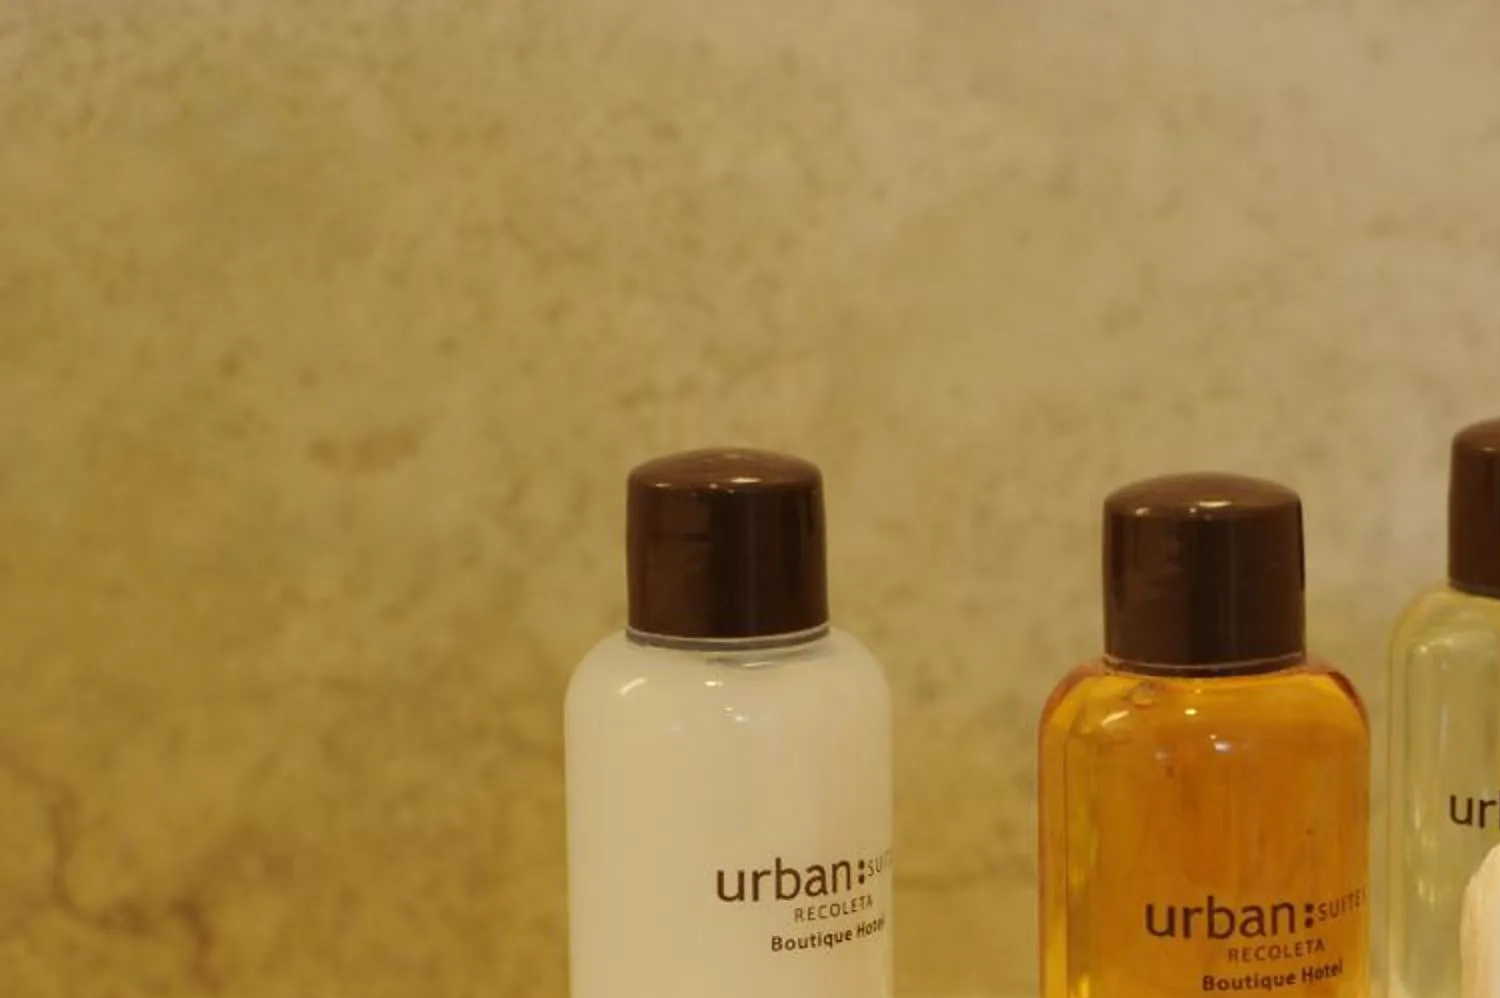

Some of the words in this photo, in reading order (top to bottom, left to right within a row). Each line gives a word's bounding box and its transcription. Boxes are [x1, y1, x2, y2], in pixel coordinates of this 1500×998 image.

[793, 894, 874, 923] RECOLETA
[771, 928, 853, 952] Boutique
[1227, 938, 1326, 963] RECOLETA
[1202, 972, 1297, 992] Boutique
[1301, 959, 1344, 984] Hotel
